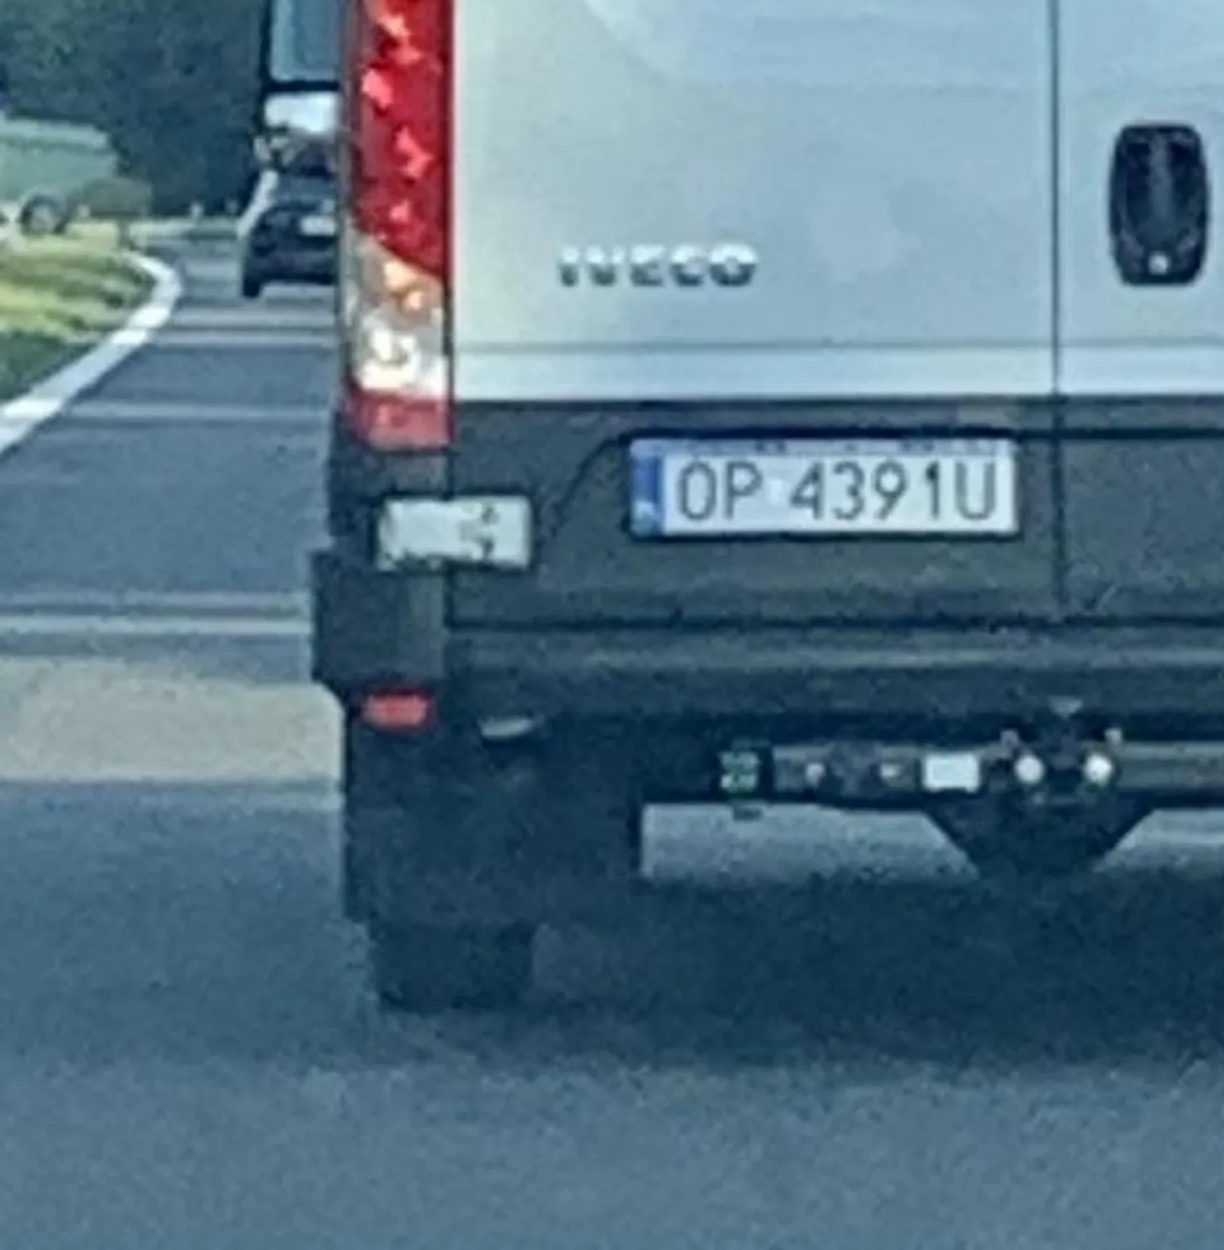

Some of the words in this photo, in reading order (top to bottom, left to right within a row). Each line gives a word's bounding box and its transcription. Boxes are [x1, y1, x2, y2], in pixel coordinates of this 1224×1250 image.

[558, 242, 758, 288] IVECO
[677, 461, 763, 521] OP
[789, 461, 997, 521] 4391U
